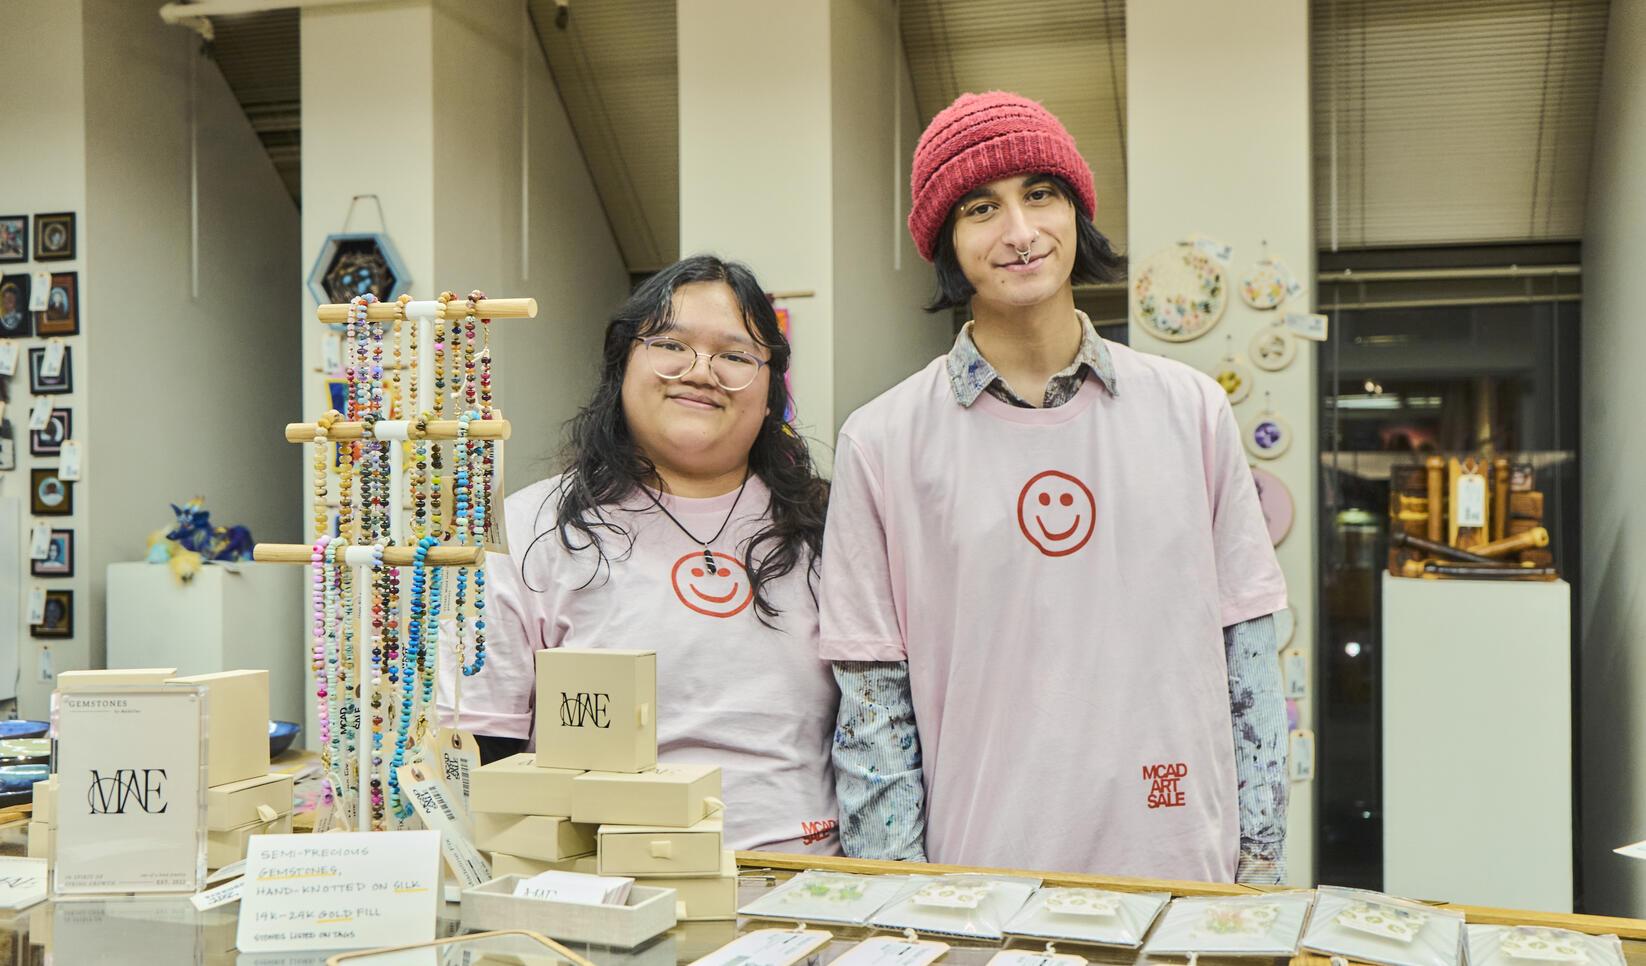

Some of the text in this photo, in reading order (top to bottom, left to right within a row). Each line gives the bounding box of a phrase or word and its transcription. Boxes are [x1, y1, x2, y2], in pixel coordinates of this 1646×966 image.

[68, 699, 128, 708] GEMSTONES
[339, 707, 348, 735] MCAD
[1142, 763, 1188, 781] MCAD
[1150, 777, 1181, 794] ART
[1147, 791, 1187, 809] SALE
[801, 819, 836, 834] MCAD
[260, 847, 370, 860] SEMI-PRECIOUS
[256, 882, 366, 896] HAND-KNOTTED
[371, 883, 388, 891] ON
[393, 880, 422, 890] SILK
[317, 908, 353, 919] GOLD
[356, 907, 381, 918] FILL
